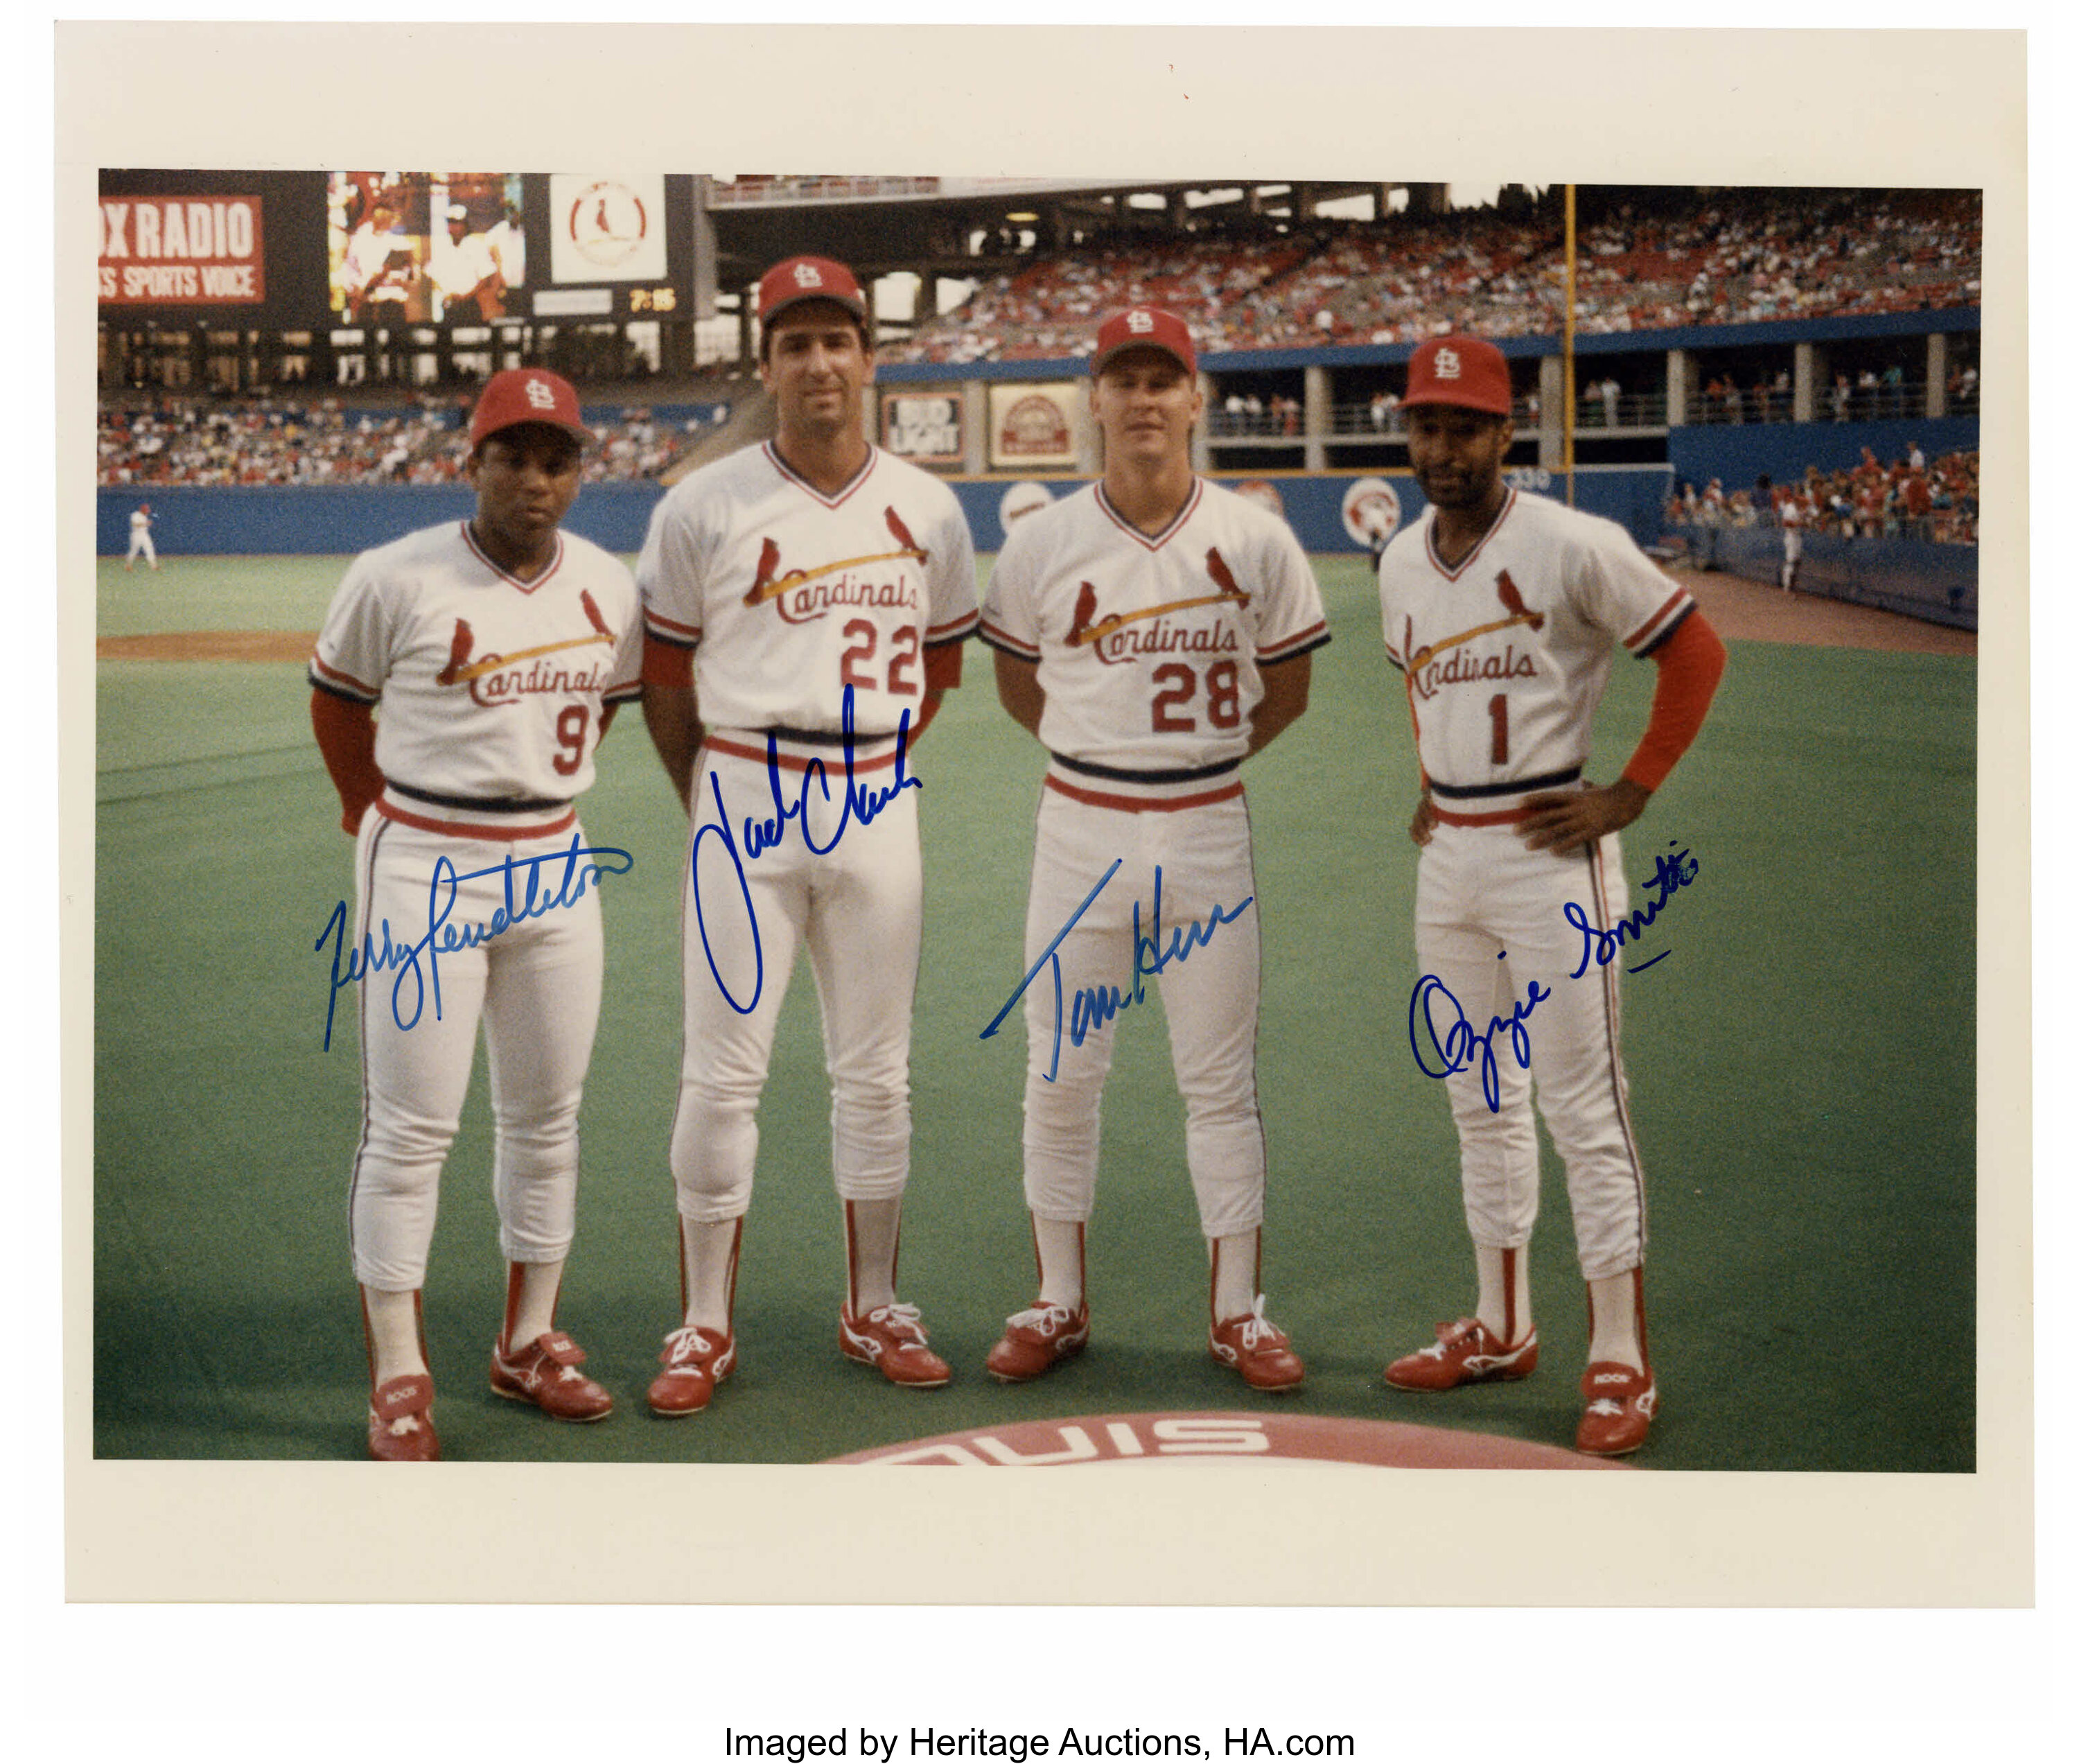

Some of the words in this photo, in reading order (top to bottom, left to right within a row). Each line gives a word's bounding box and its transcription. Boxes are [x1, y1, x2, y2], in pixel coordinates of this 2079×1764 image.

[135, 202, 254, 258] RADIO
[123, 265, 198, 297] SPORTS
[200, 265, 256, 297] VOICE
[777, 569, 917, 624] Cardinals
[841, 618, 918, 696] 22
[1094, 614, 1238, 665] Cardinals
[1152, 660, 1240, 733] 28
[552, 705, 588, 776] 9
[1489, 694, 1508, 764] 1
